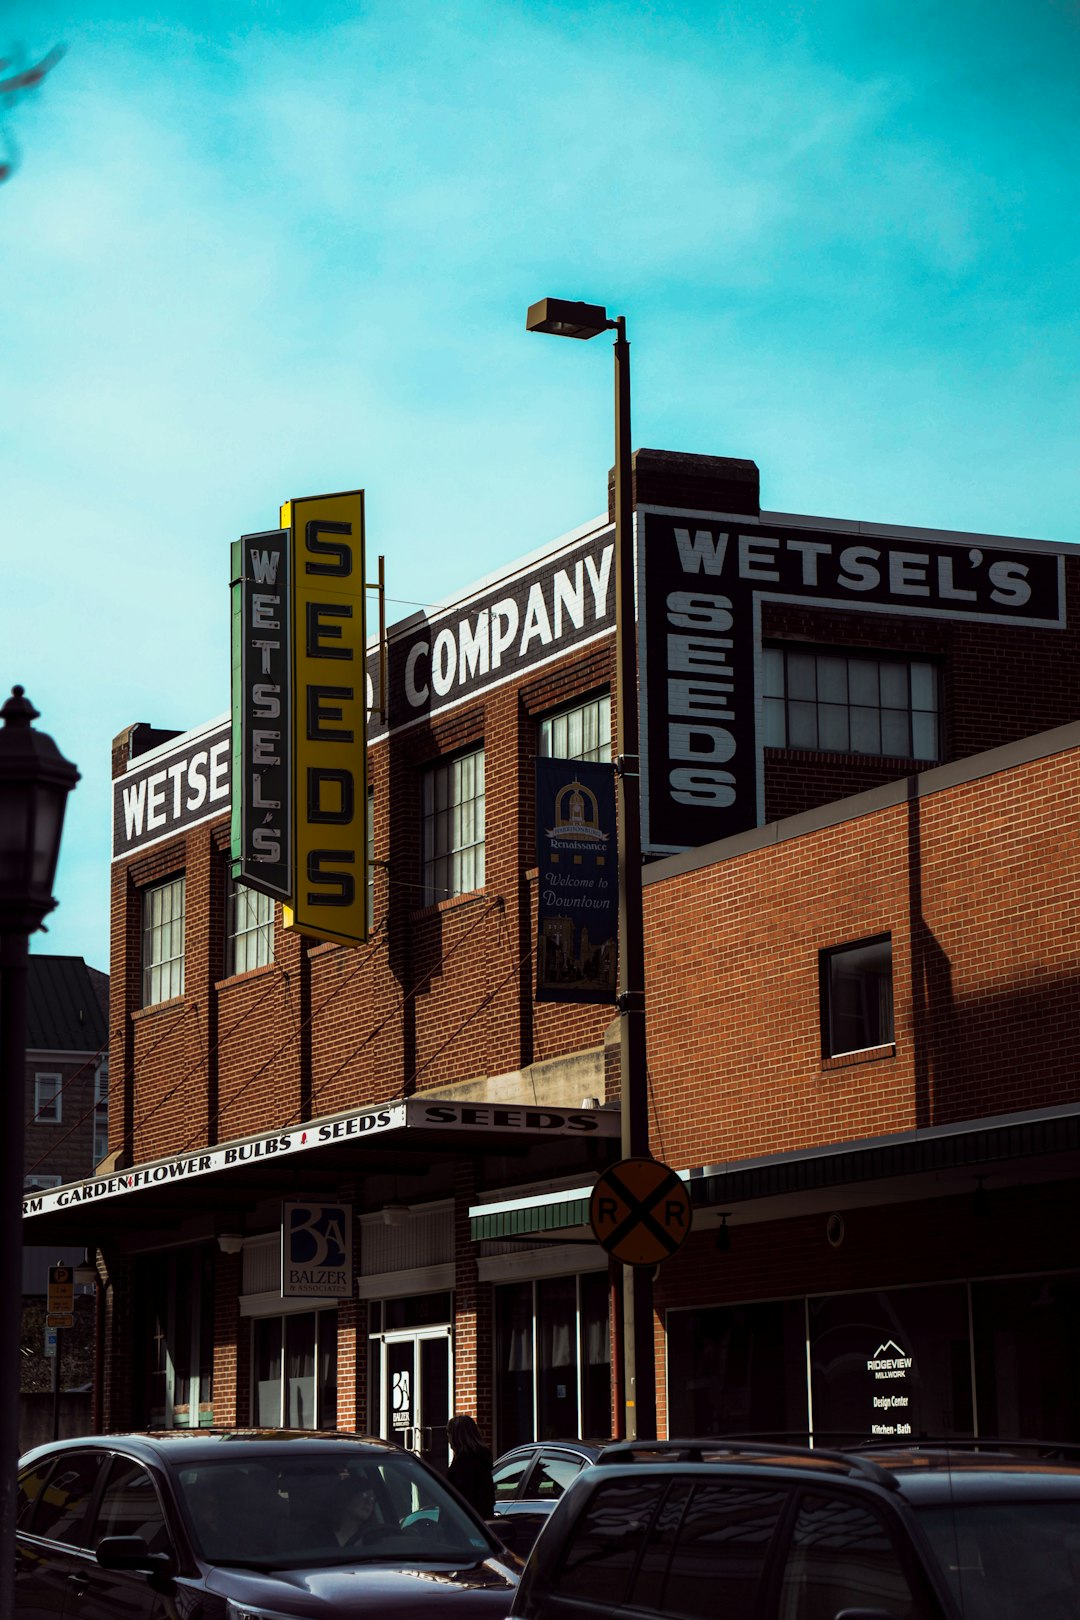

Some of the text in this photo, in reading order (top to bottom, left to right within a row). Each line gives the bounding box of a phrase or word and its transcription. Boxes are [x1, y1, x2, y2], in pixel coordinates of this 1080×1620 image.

[672, 527, 1033, 608] WETSEL'S
[404, 543, 615, 708] COMPANY
[249, 548, 282, 864] WETSEL'S
[666, 590, 738, 809] SEEDS
[305, 519, 356, 908] SEEDS
[550, 839, 608, 852] Renaissance
[545, 872, 609, 889] Welcome to
[542, 890, 611, 910] Downtown
[425, 1106, 599, 1132] SEEDS
[56, 1177, 129, 1207] GARDEN
[133, 1155, 212, 1187] FLOWER
[224, 1135, 292, 1165] BULBS
[318, 1110, 392, 1142] SEEDS
[598, 1198, 685, 1227] R R
[290, 1270, 347, 1285] BALZER
[866, 1357, 913, 1371] RIDGEVIEW
[874, 1370, 906, 1380] MILLWORK
[873, 1395, 909, 1411] Design Center
[871, 1422, 912, 1435] Kitchen Bath
